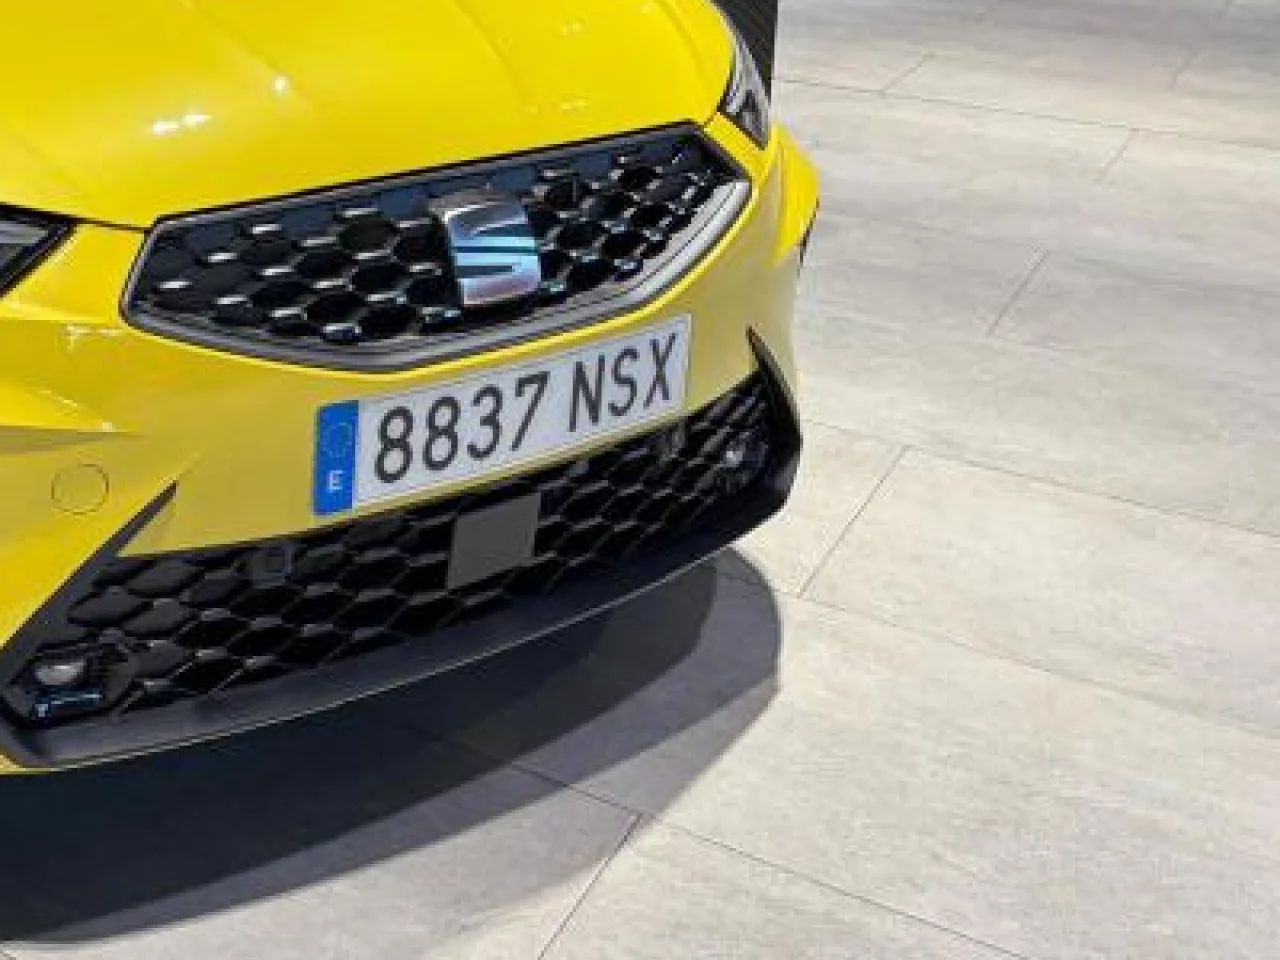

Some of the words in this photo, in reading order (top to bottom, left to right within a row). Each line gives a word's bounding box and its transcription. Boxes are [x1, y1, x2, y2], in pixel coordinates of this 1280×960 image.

[373, 370, 550, 483] 8837
[568, 332, 677, 433] NSX
[327, 469, 343, 491] E
